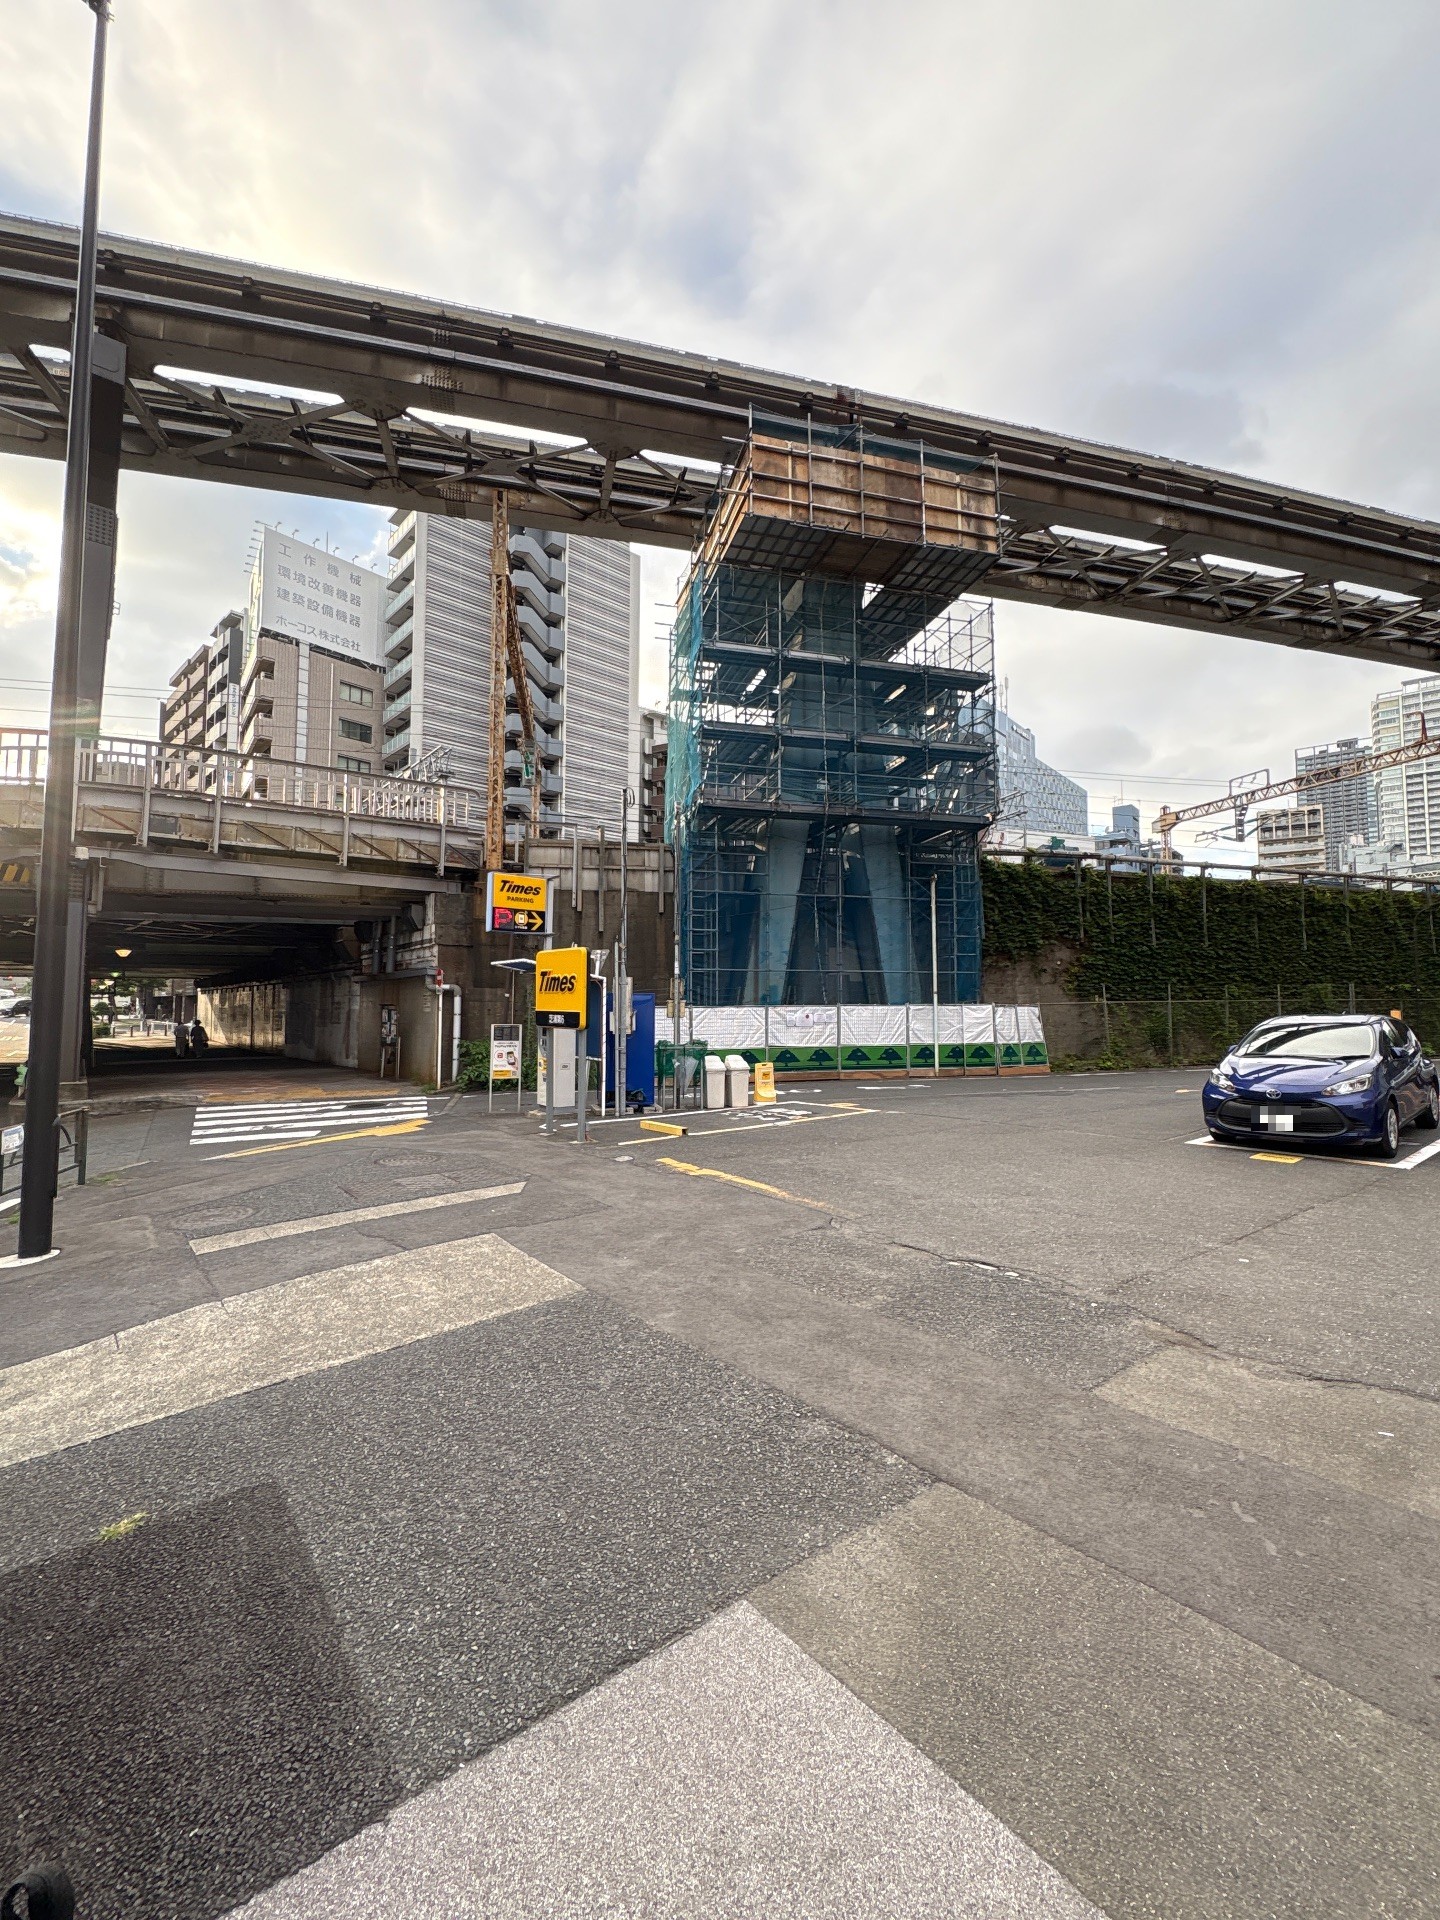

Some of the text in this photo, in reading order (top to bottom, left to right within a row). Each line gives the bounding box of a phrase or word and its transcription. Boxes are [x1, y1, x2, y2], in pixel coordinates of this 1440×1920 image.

[278, 543, 362, 587] 工作機械
[277, 564, 362, 608] 環境改善機器
[276, 587, 361, 628] 建築設備機器
[275, 615, 361, 653] ホーコス株式会社
[499, 880, 542, 896] Times
[506, 896, 535, 904] PARKING
[539, 970, 577, 992] Times
